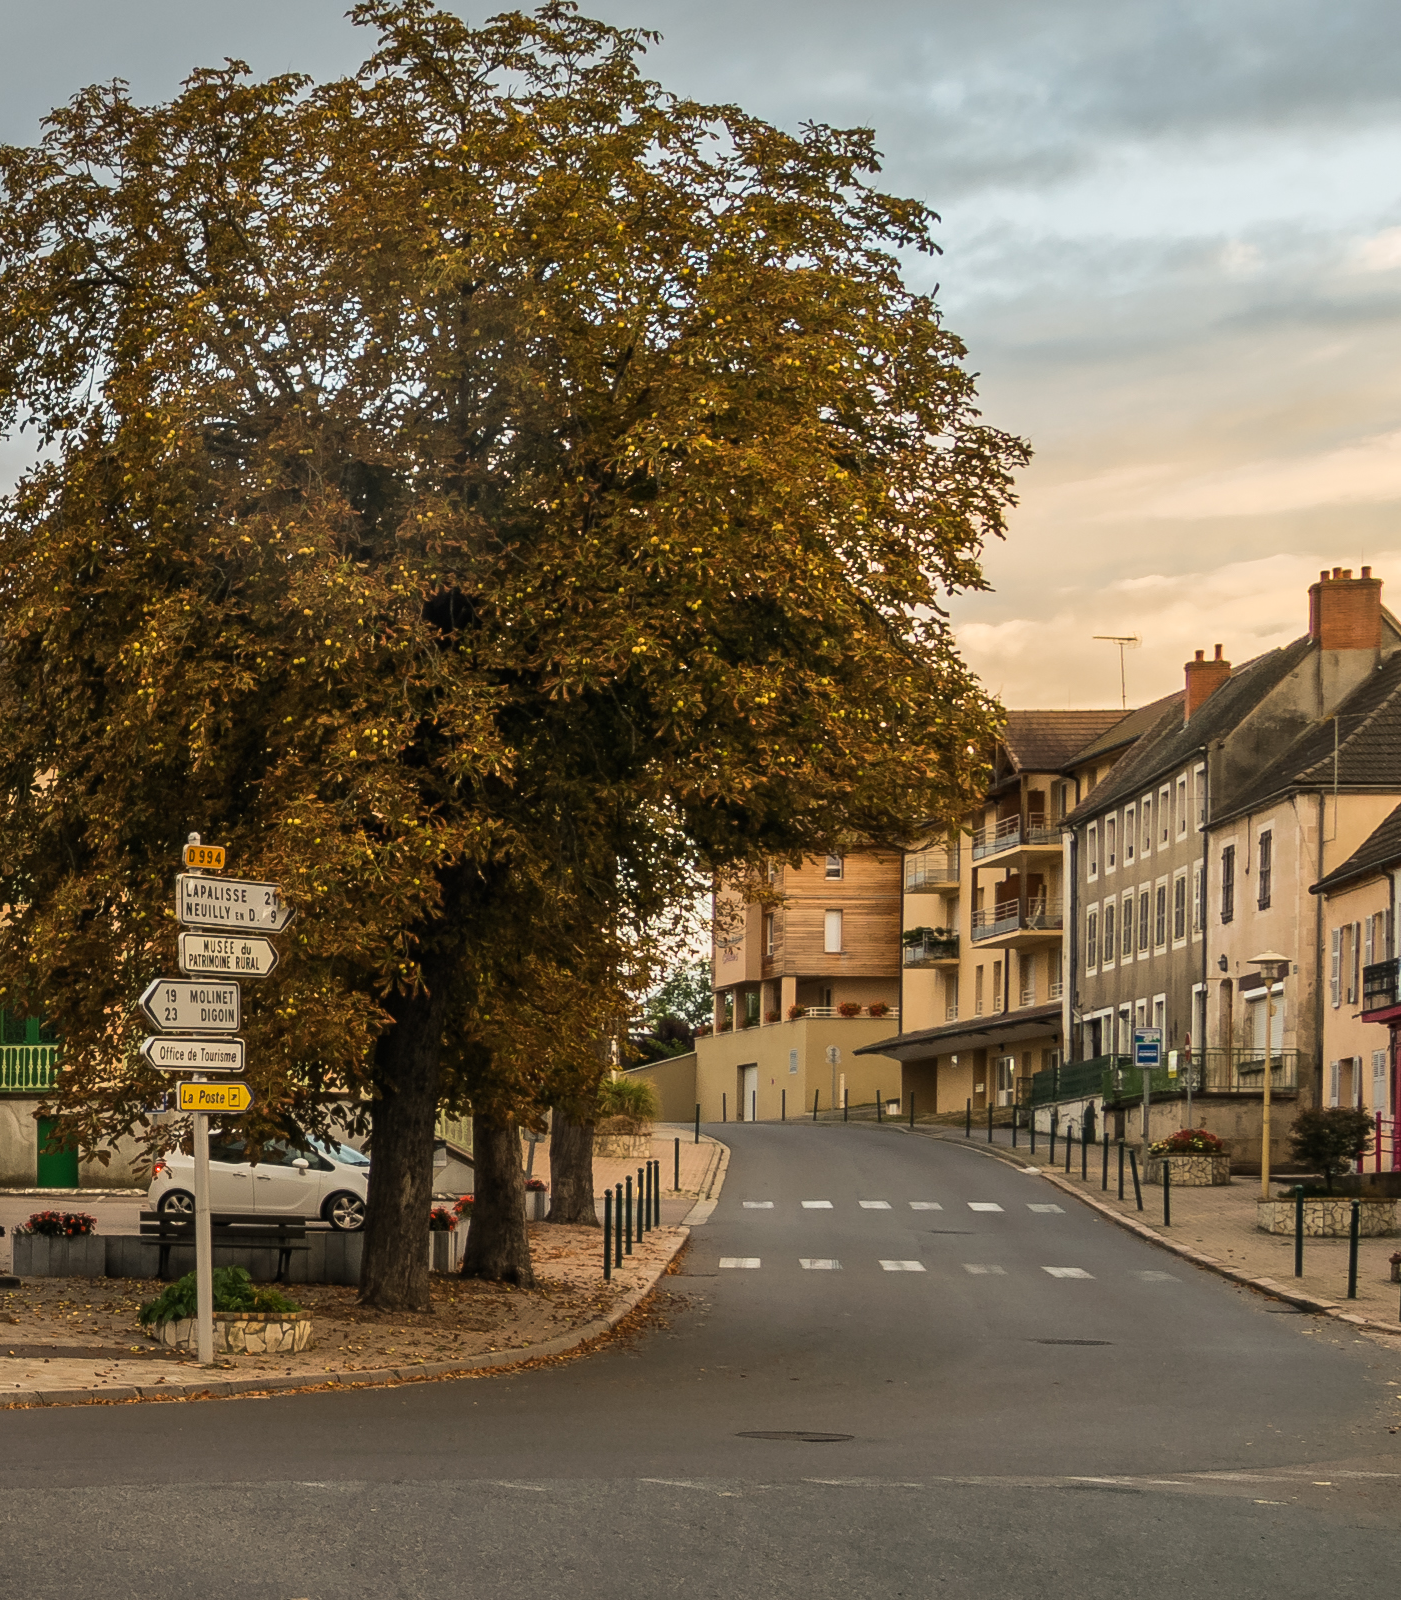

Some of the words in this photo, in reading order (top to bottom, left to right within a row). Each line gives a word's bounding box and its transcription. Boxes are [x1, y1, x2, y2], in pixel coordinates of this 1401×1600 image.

[189, 849, 195, 863] D
[199, 850, 222, 865] 994
[186, 883, 247, 903] LAPALISSE
[264, 891, 277, 906] 21
[186, 902, 231, 920] NEUILLY
[235, 911, 245, 921] EN
[249, 908, 260, 922] D.
[271, 910, 277, 924] 9
[203, 938, 234, 954] MUSÉE
[241, 942, 251, 955] du
[189, 954, 231, 969] PATRIMOINE
[235, 956, 260, 971] RURAL
[165, 989, 177, 1003] 19
[190, 990, 234, 1004] MOLINET
[165, 1007, 177, 1021] 23
[201, 1008, 234, 1022] DIGOIN
[160, 1046, 184, 1060] Office
[187, 1048, 197, 1061] de
[200, 1048, 237, 1063] Tourisme
[182, 1090, 193, 1104] La
[199, 1090, 225, 1104] Poste
